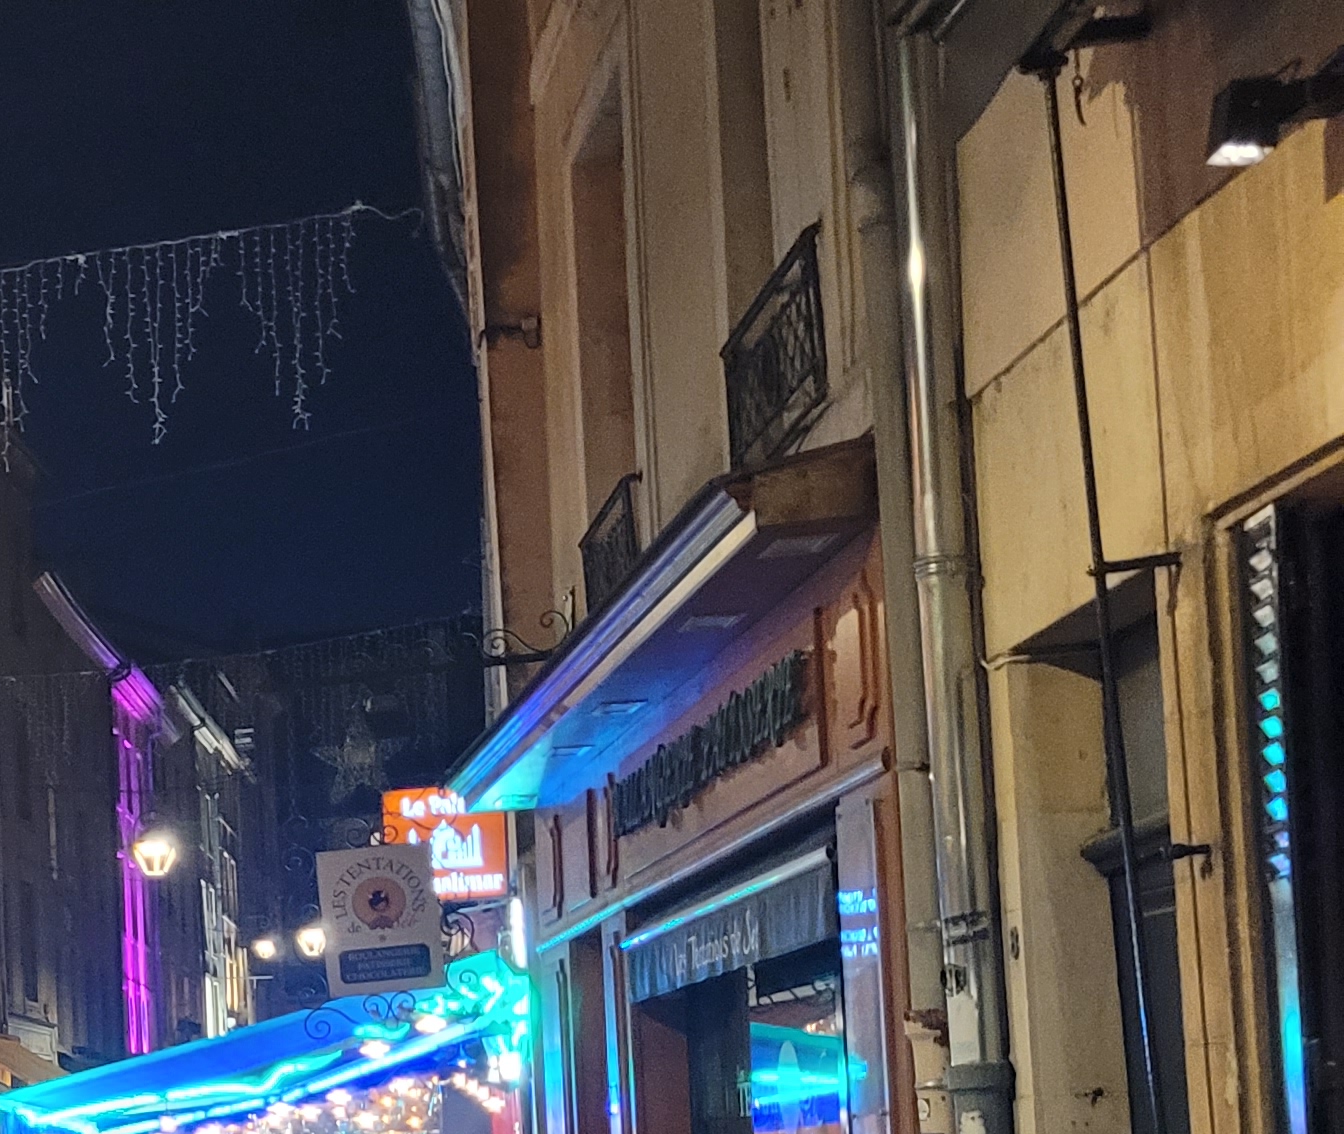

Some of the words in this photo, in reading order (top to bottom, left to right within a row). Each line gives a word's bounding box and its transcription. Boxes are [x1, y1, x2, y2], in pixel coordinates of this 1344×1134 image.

[336, 856, 428, 913] TENTATIONS
[433, 871, 504, 894] alimar
[332, 889, 348, 919] LES
